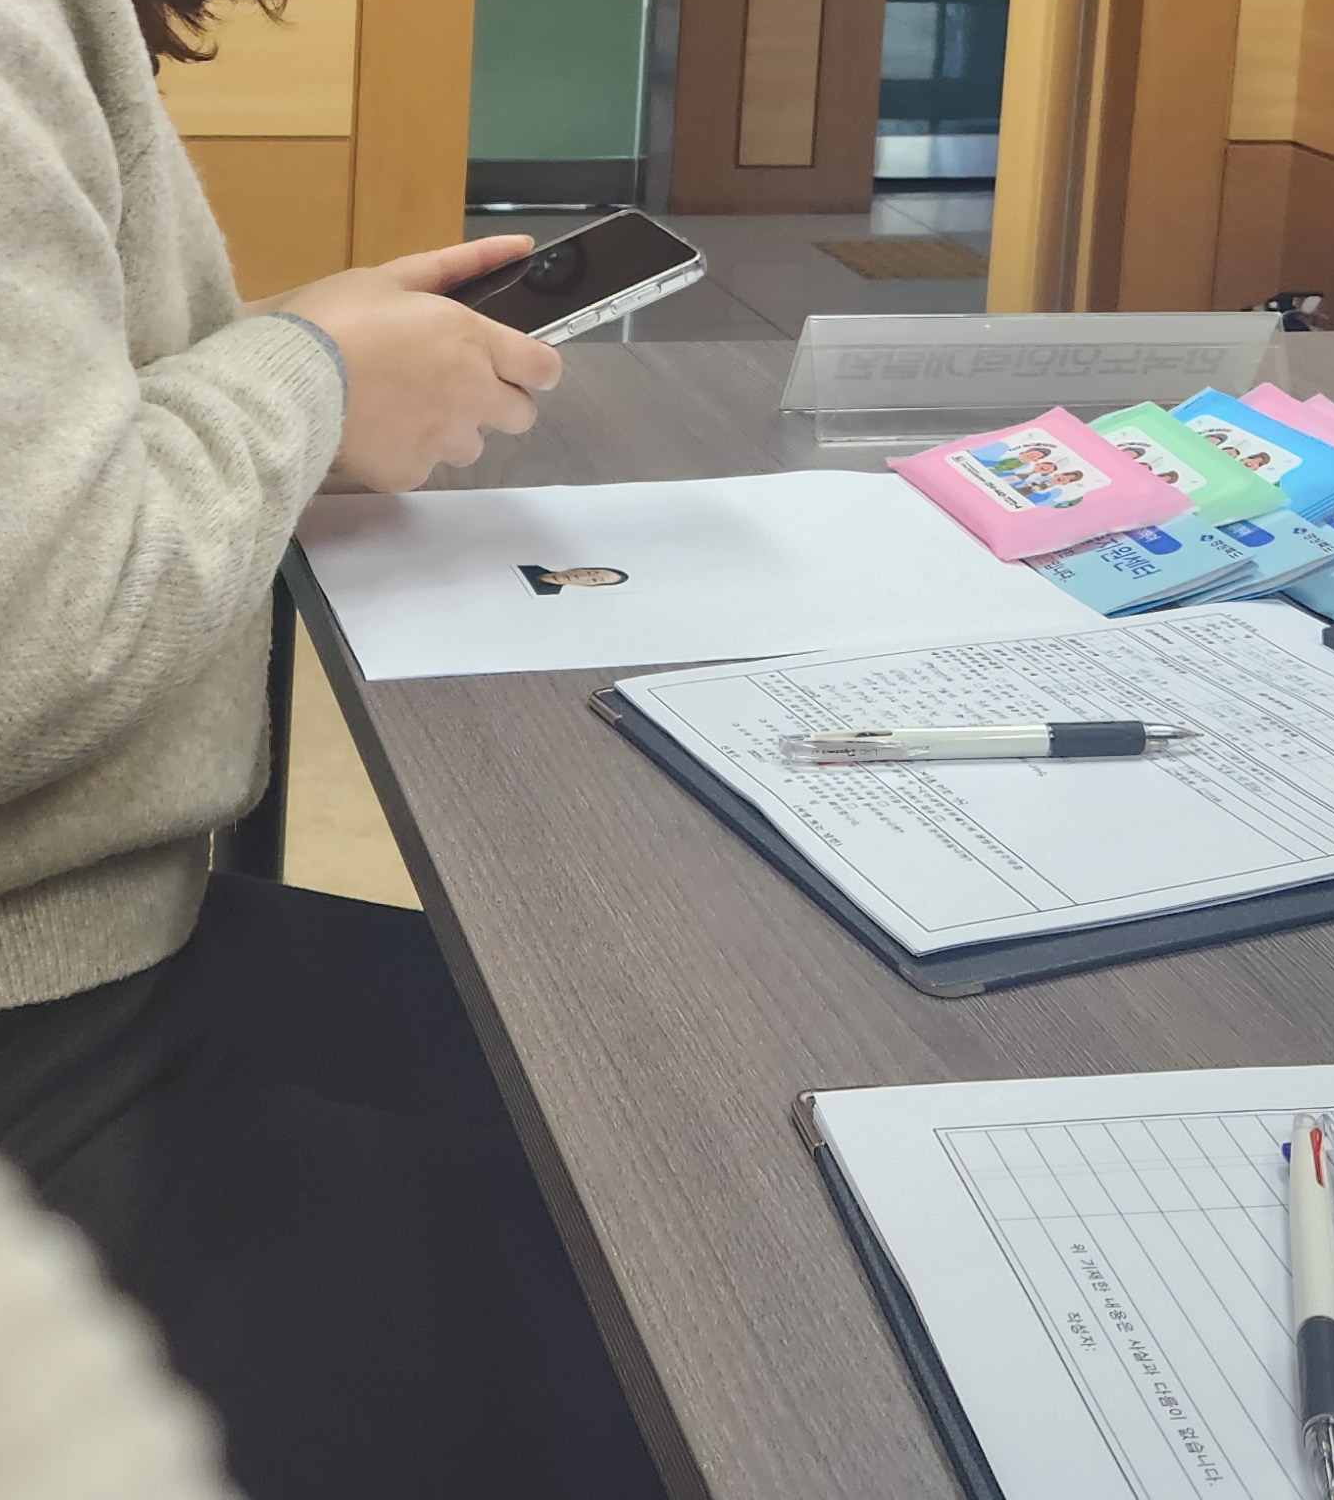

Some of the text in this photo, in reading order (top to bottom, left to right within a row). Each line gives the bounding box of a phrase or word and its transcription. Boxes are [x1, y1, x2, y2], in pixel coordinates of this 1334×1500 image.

[1210, 538, 1245, 559] 경상북도
[1066, 1311, 1098, 1352] 작성자:
[1069, 1242, 1224, 1487] 위 기재한 내용은 사실과 다름이 없습니다.
